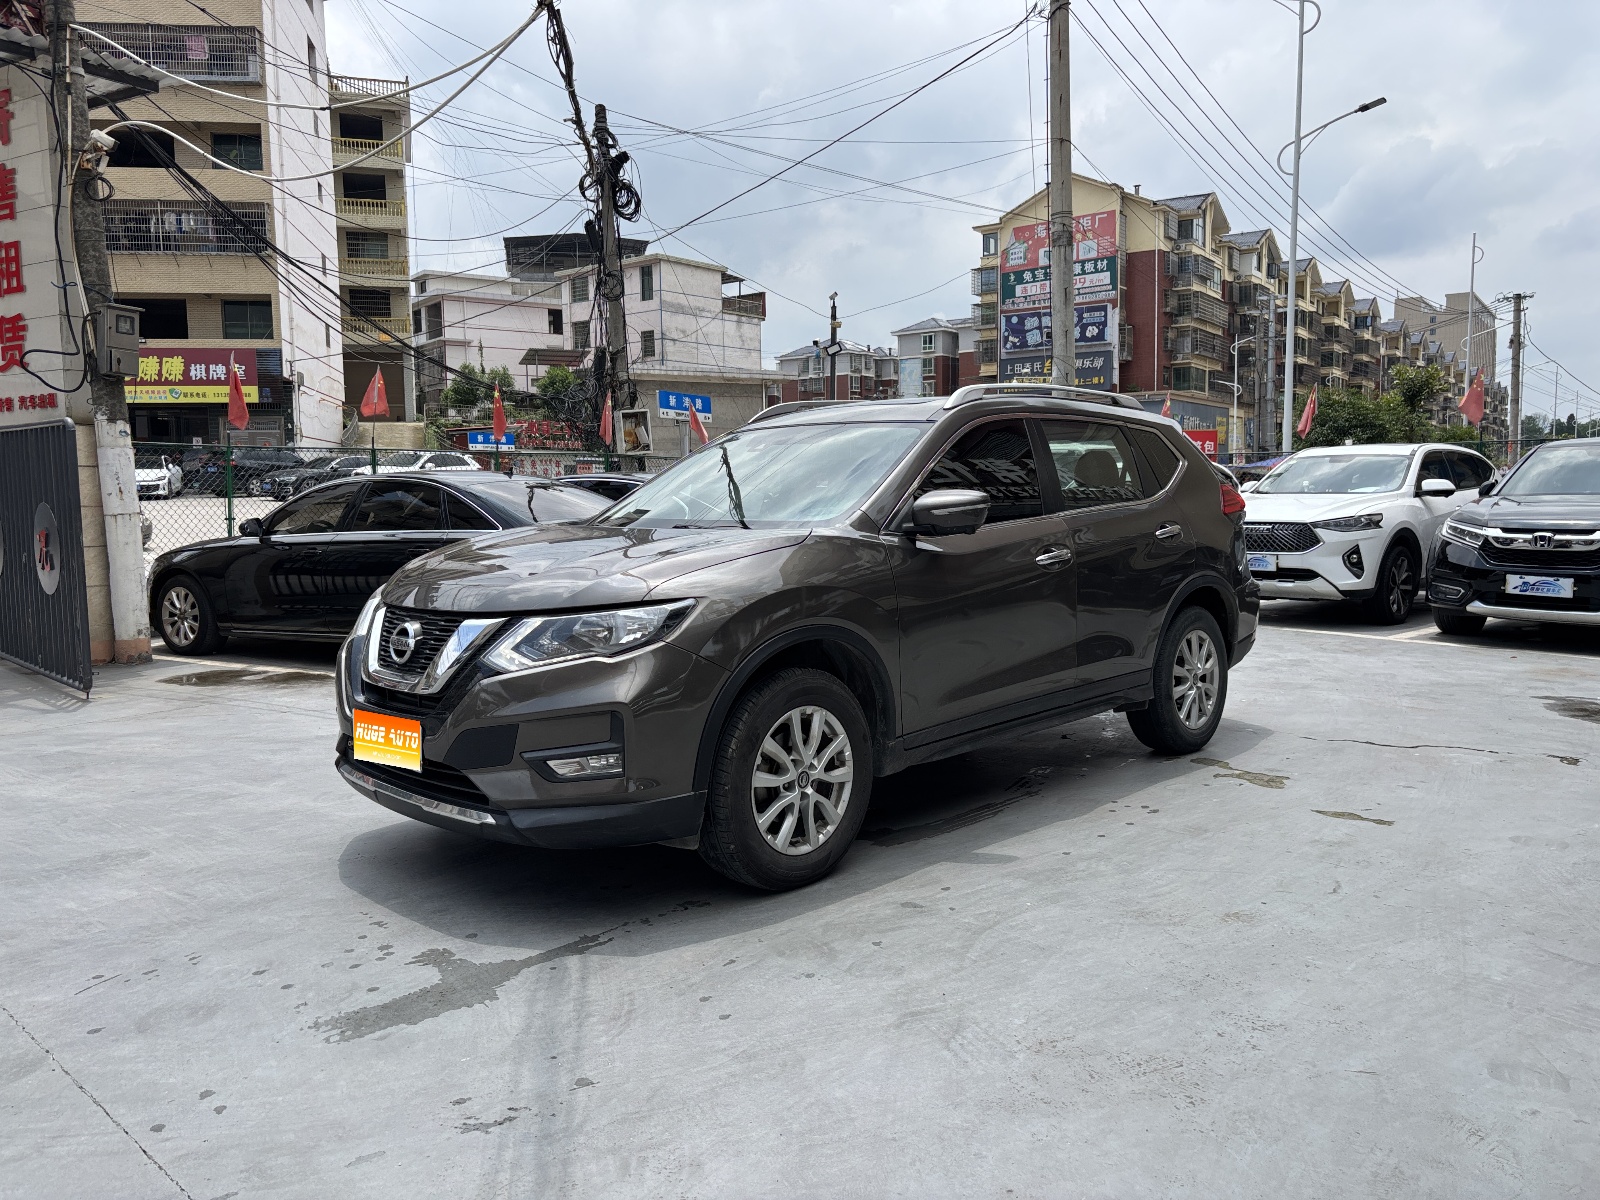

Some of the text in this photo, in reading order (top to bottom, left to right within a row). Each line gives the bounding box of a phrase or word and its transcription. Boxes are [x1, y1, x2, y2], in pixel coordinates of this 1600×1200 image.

[1034, 214, 1108, 239] 海柜厂
[1022, 259, 1108, 283] 兔宝康板材
[1004, 356, 1105, 375] 上田乔氏台俱乐部
[18, 393, 58, 410] 汽车出租
